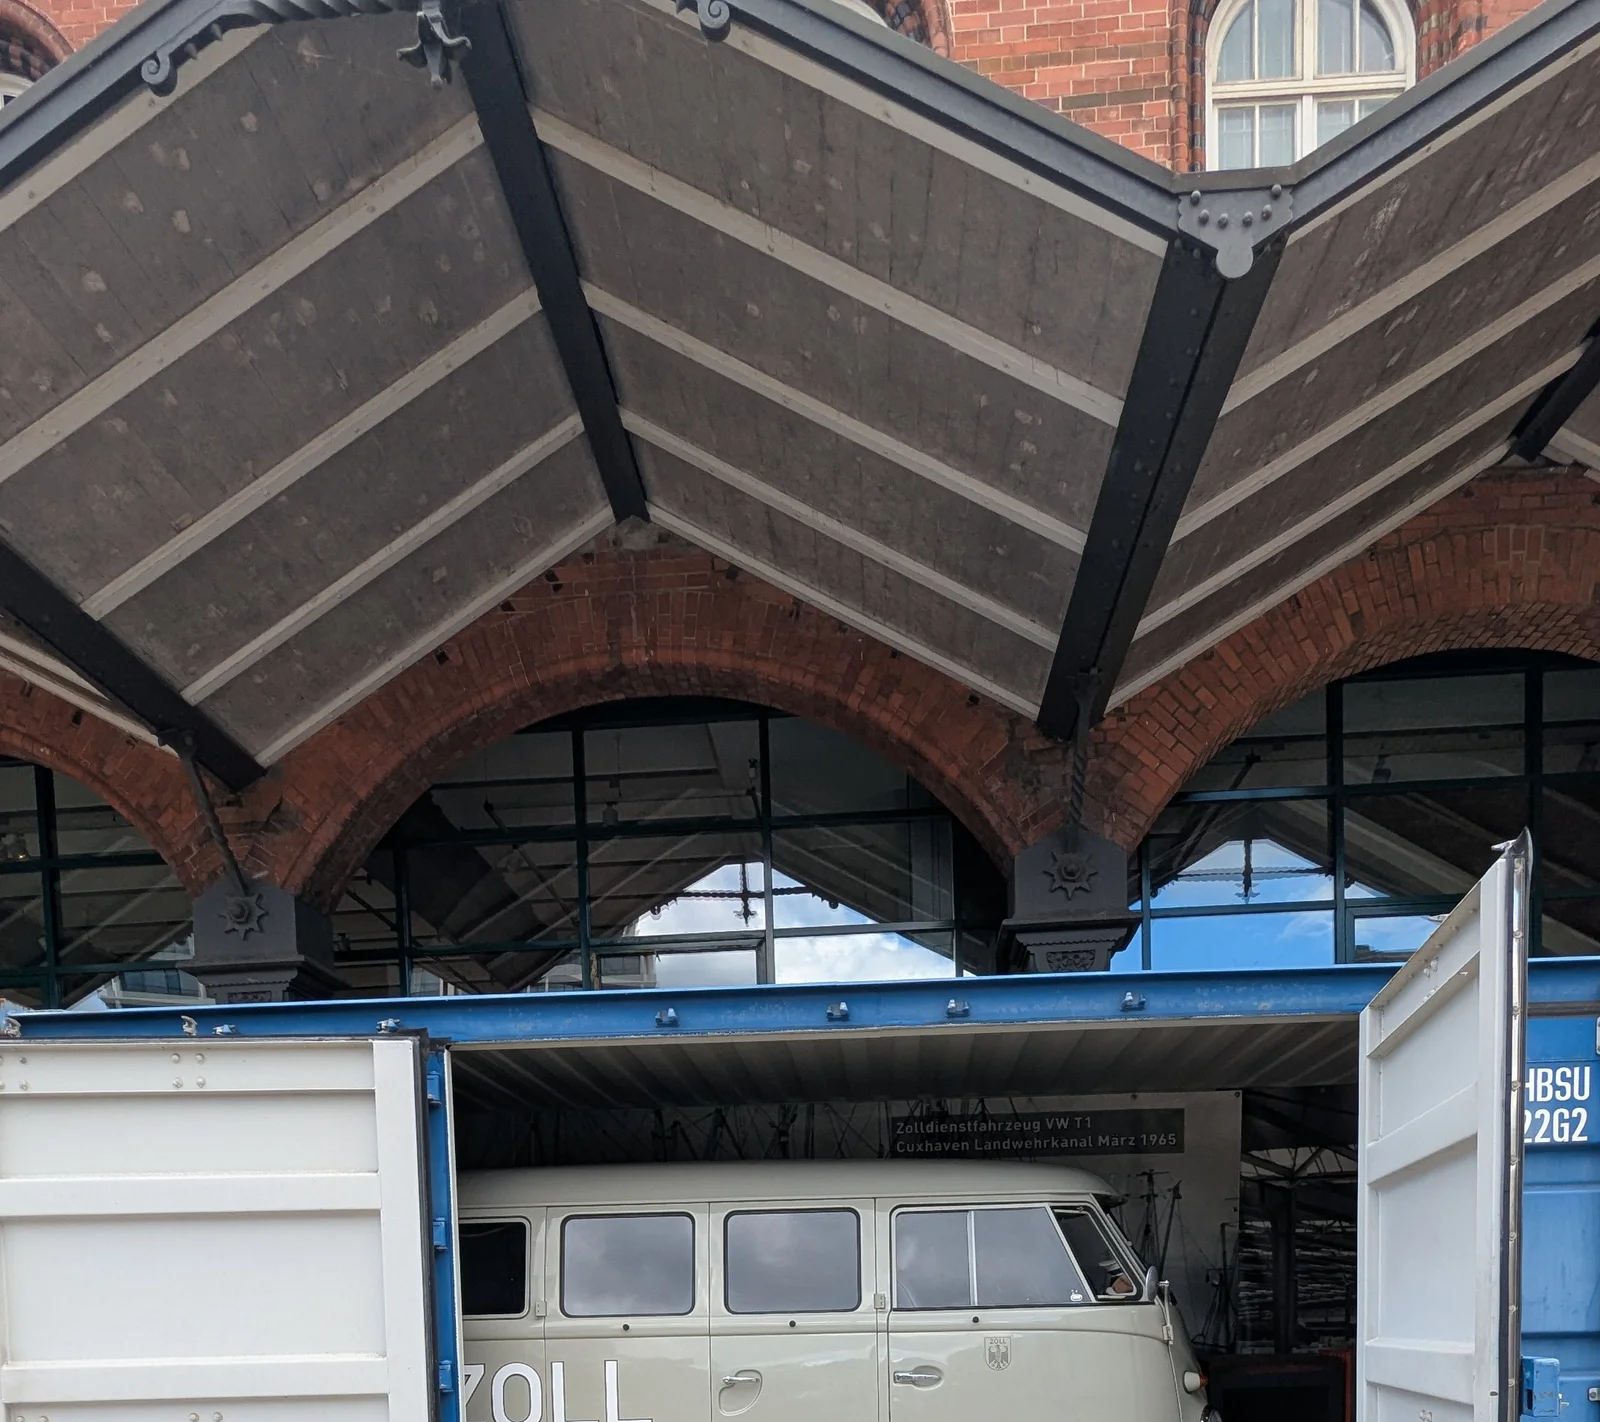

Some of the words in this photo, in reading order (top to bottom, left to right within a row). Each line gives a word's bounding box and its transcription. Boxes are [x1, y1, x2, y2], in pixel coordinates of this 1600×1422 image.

[895, 1119, 1041, 1135] Zolldienstfahrzeug
[1046, 1117, 1070, 1130] VW
[1074, 1116, 1092, 1129] T1
[895, 1139, 971, 1153] Cuxhaven
[974, 1135, 1093, 1151] Landwehrkanal
[1098, 1133, 1136, 1147] März
[1140, 1133, 1177, 1146] 1965
